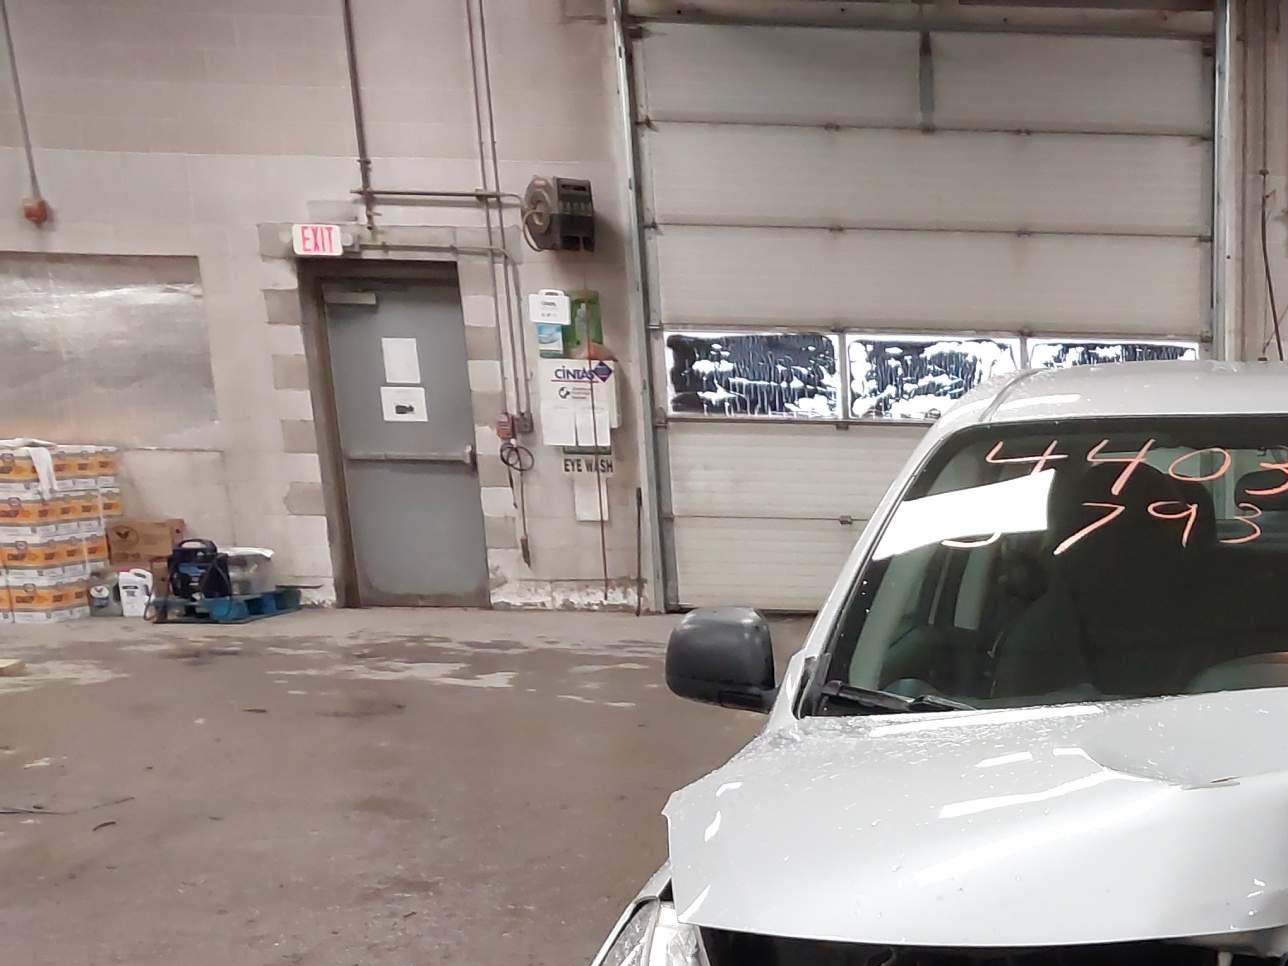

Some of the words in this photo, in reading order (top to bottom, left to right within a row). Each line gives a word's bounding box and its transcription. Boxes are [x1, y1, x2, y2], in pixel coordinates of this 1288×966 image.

[301, 226, 333, 252] EXIT
[564, 458, 583, 472] EYE
[941, 500, 1262, 556] 793
